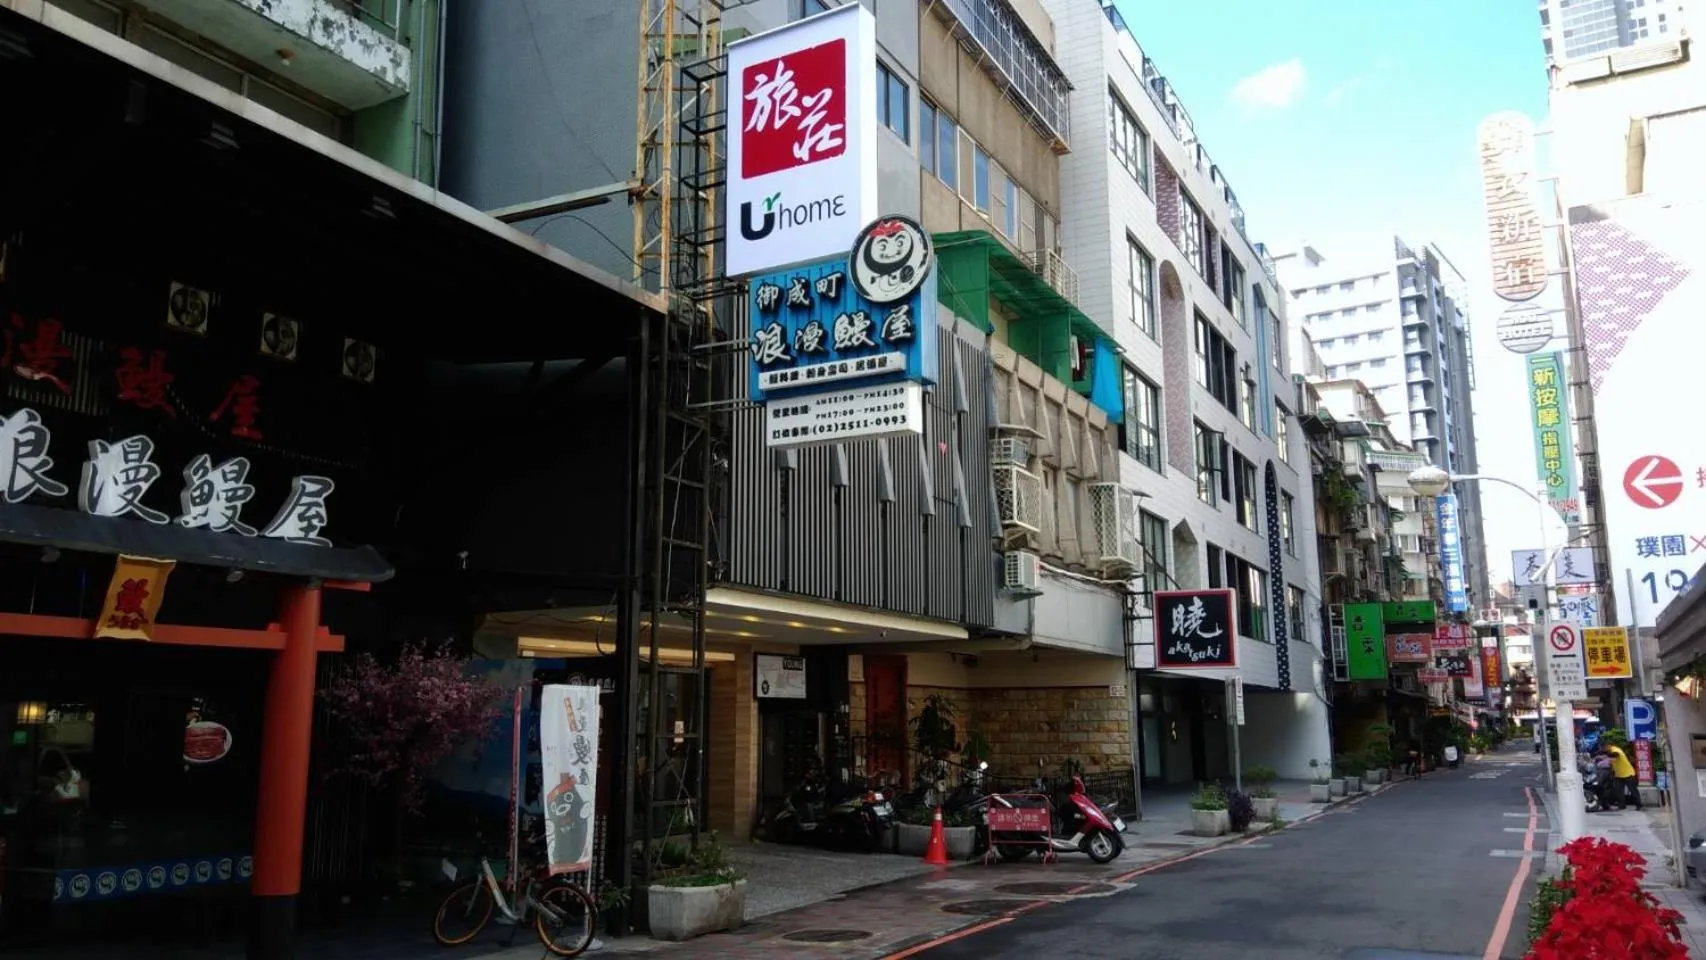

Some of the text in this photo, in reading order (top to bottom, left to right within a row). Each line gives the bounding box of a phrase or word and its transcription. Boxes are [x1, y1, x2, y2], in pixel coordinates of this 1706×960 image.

[756, 272, 842, 311] 御成町
[752, 304, 912, 364] 浪漫鰻屋
[1168, 641, 1222, 662] akatsuki
[1588, 646, 1626, 665] 停車場
[1627, 701, 1655, 740] P
